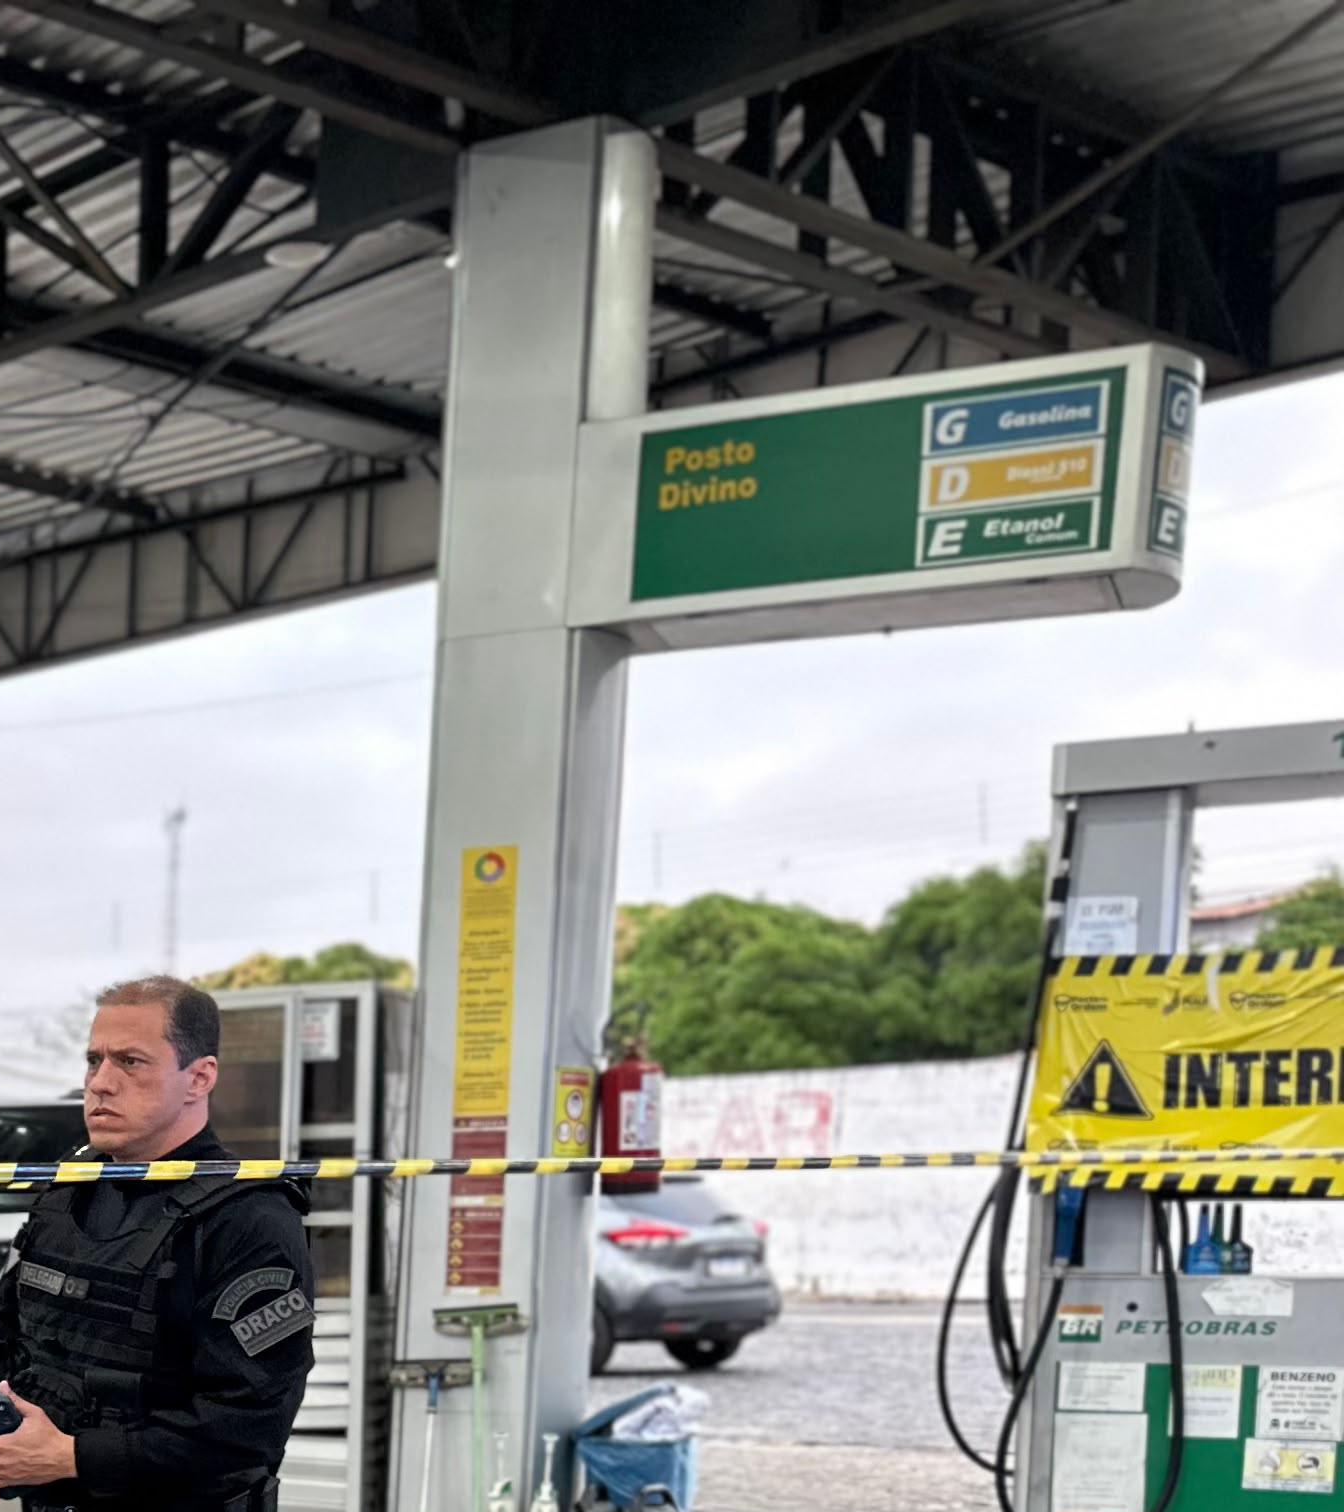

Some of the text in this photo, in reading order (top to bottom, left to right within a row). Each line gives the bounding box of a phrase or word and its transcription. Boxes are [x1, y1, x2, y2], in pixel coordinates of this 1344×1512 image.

[935, 404, 1092, 445] G Gasolina
[1170, 391, 1190, 426] G
[664, 438, 757, 477] Posto
[658, 474, 758, 512] Divino
[938, 464, 970, 501] D
[927, 512, 1065, 558] E Etanol
[1158, 508, 1179, 543] E
[1163, 1047, 1344, 1110] INTER
[234, 1294, 306, 1342] DRACO
[1061, 1319, 1278, 1336] BR PETOBRAS
[1270, 1371, 1336, 1383] BENZENO
